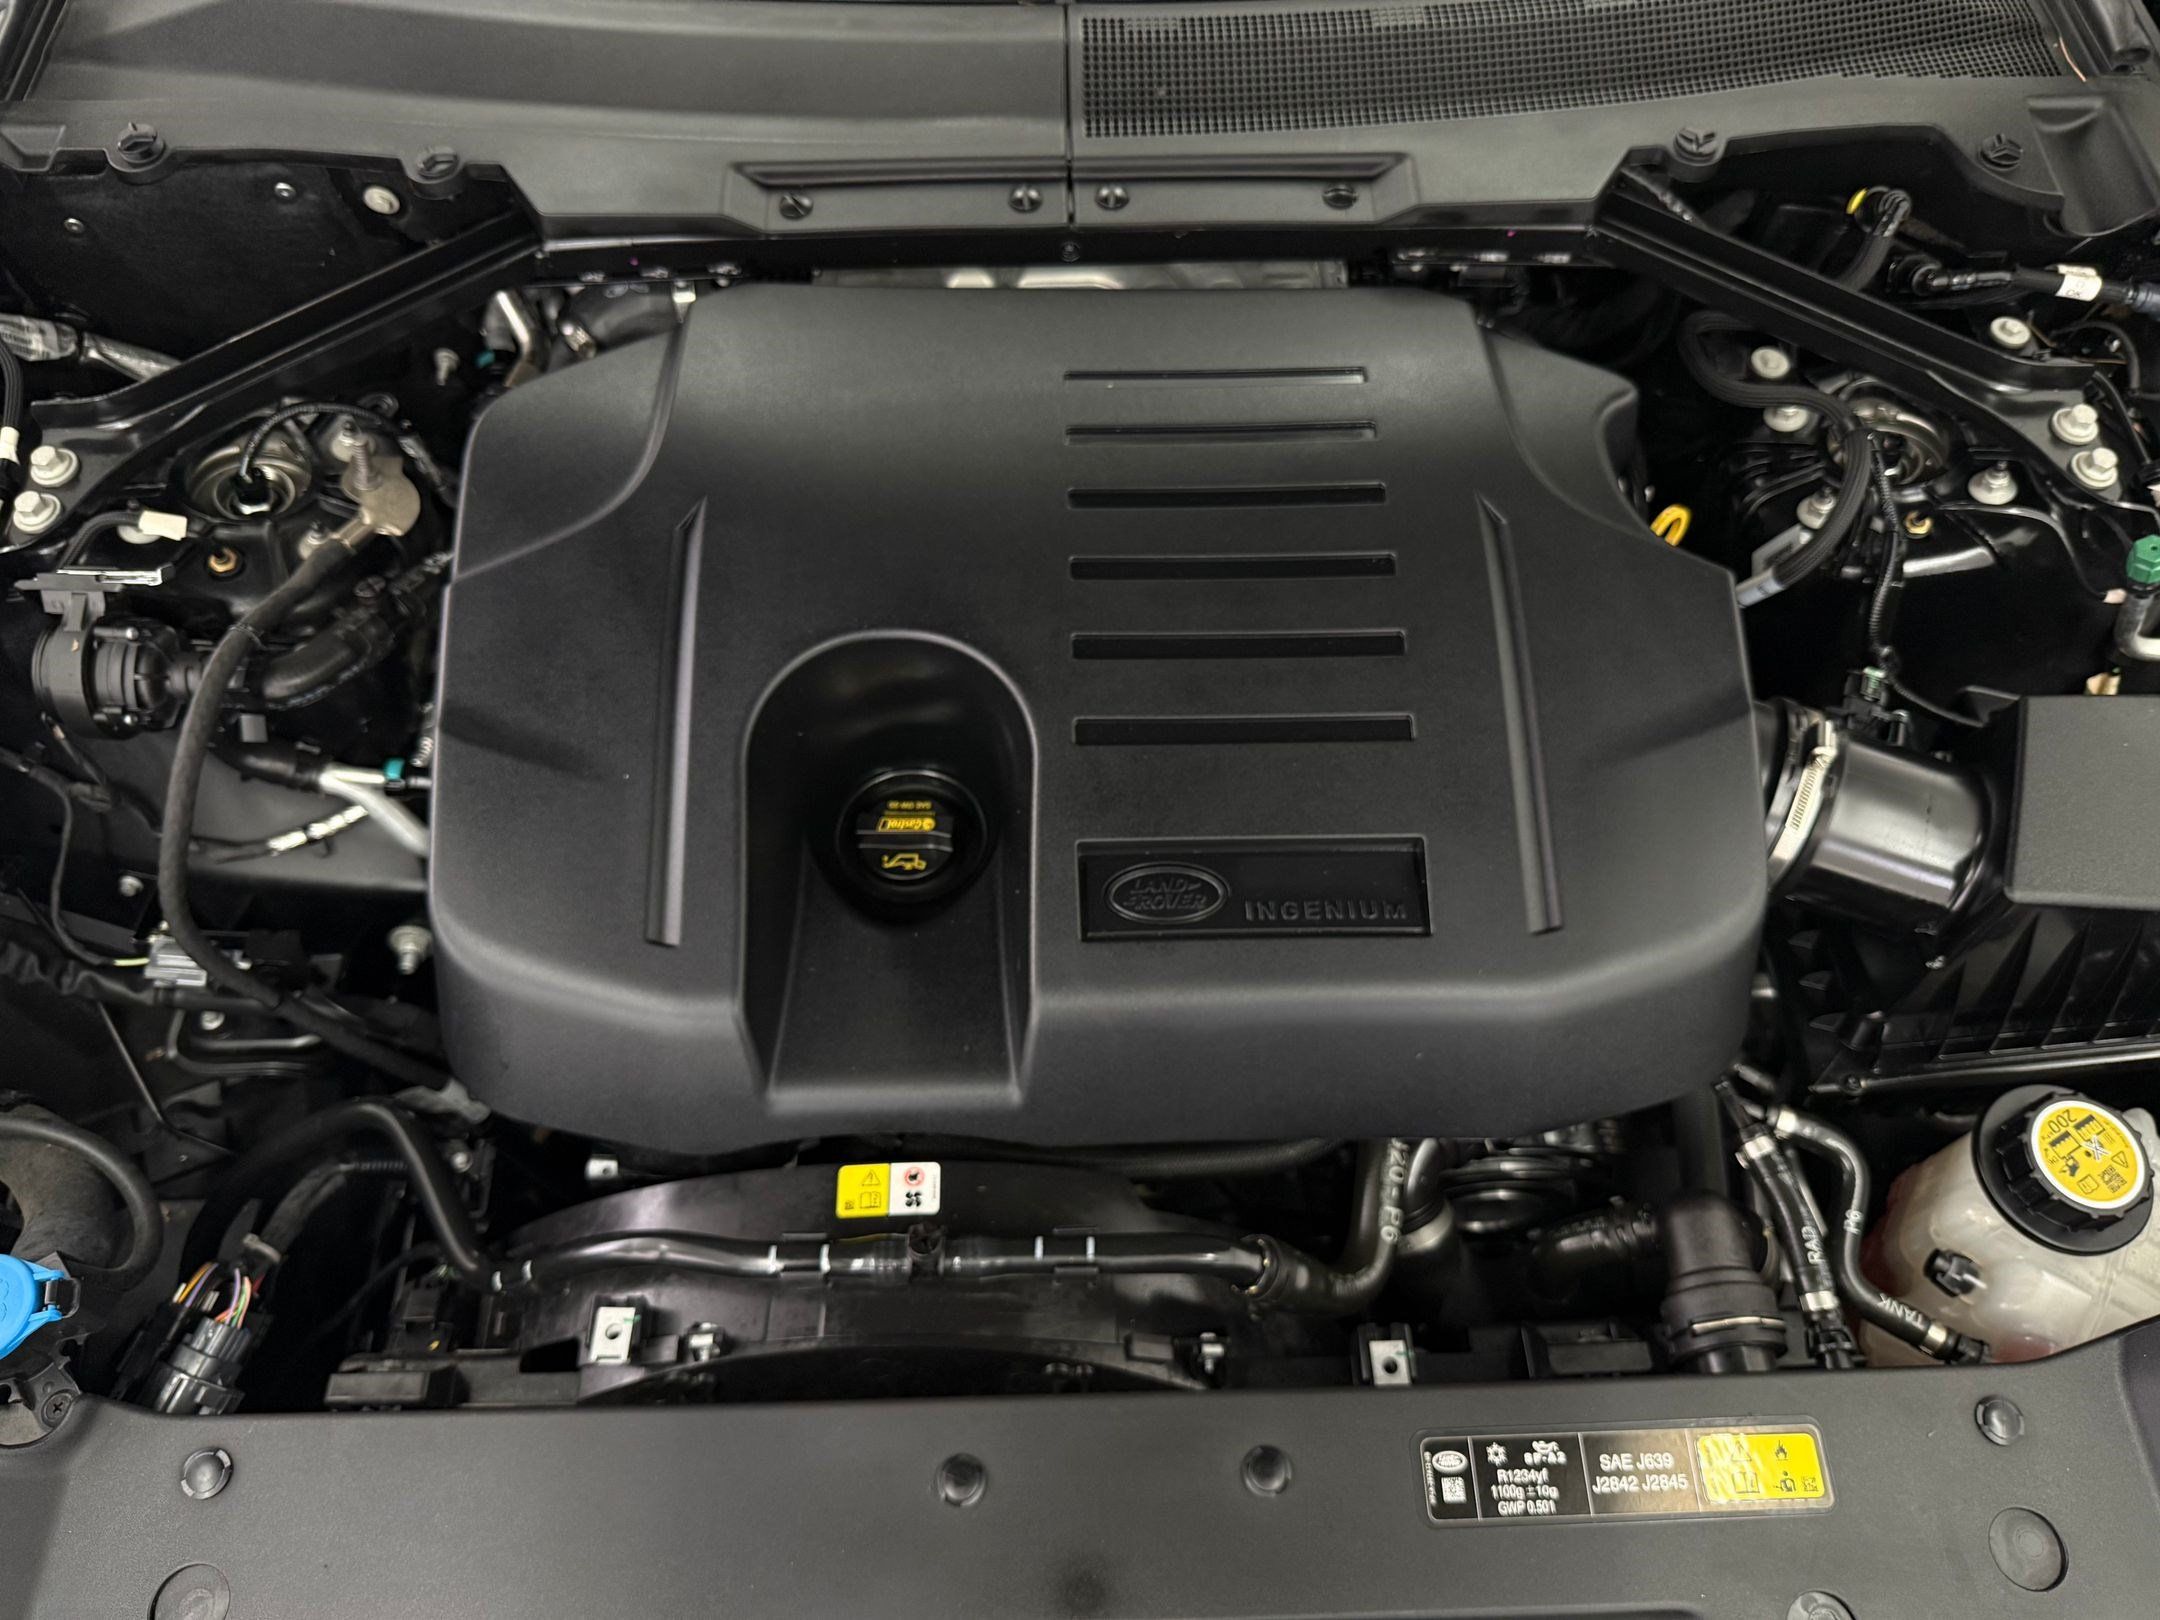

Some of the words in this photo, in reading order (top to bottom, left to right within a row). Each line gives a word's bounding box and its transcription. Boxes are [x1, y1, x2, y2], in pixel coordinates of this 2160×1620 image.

[887, 817, 922, 831] Castrol
[1131, 879, 1195, 895] LAND
[1132, 895, 1207, 912] ROVER
[1244, 900, 1408, 921] INGENIUM
[2048, 1109, 2077, 1134] 200
[1801, 1225, 1826, 1265] RAD
[1879, 1293, 1927, 1330] TANK
[1600, 1454, 1633, 1471] SAE
[1635, 1453, 1674, 1470] J639
[1497, 1468, 1549, 1486] R1234yf
[1592, 1476, 1638, 1494] J2842
[1641, 1473, 1689, 1491] J2845
[1491, 1484, 1525, 1501] 1100g
[1498, 1500, 1525, 1516] GWP
[1526, 1499, 1557, 1515] 0.501
